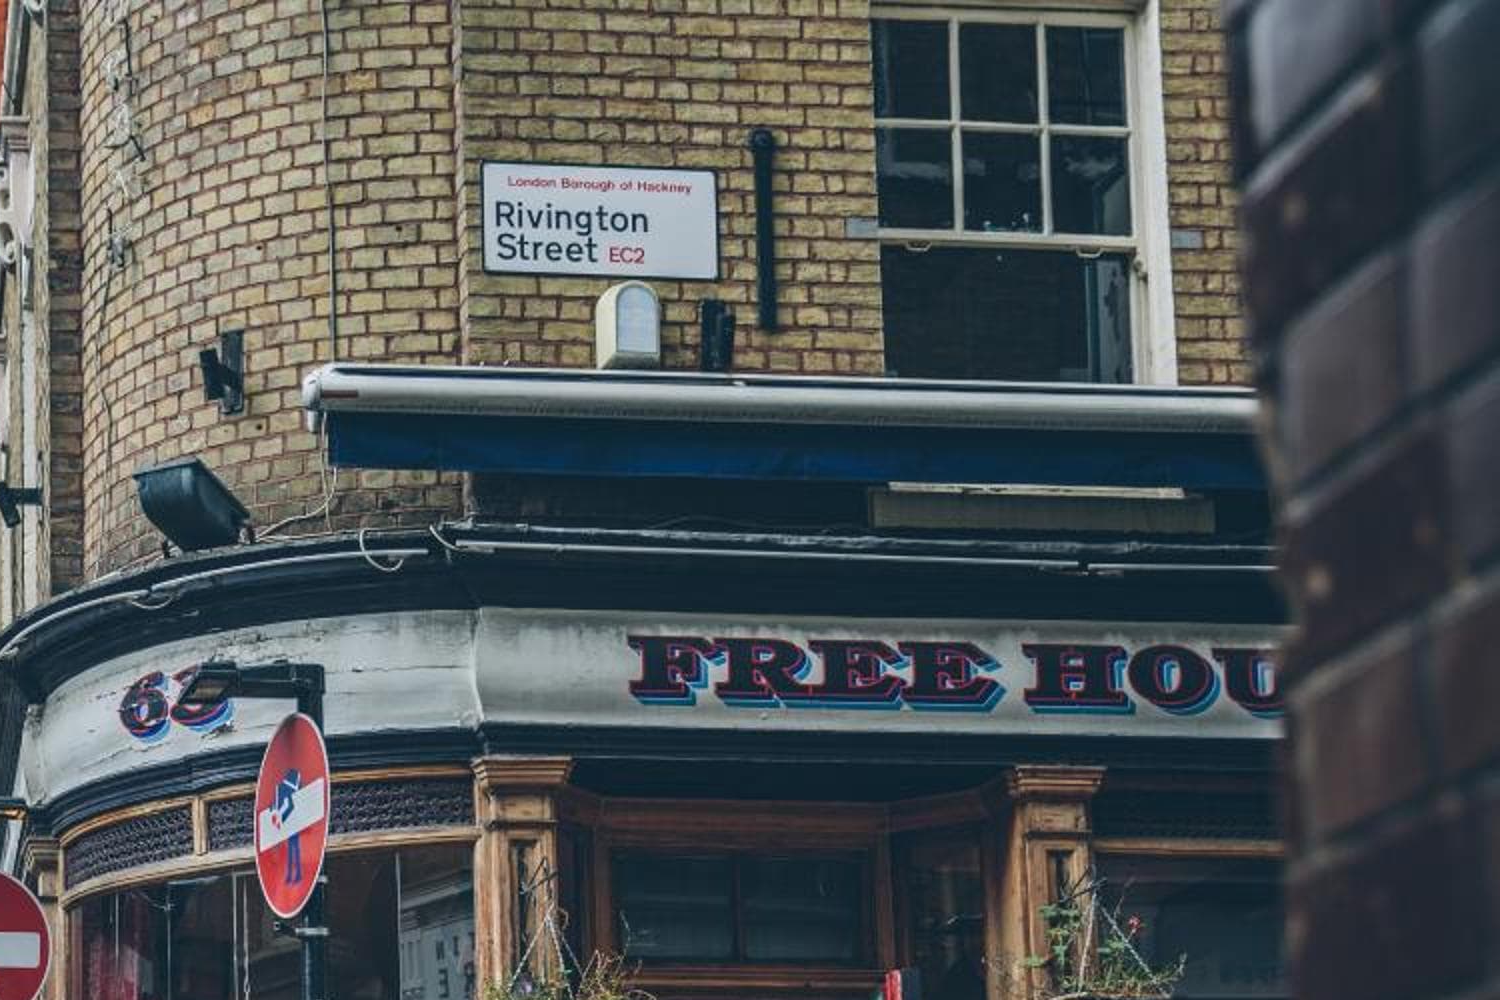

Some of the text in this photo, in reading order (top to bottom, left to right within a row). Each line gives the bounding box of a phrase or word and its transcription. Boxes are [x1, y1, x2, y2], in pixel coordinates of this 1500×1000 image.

[507, 175, 692, 195] London Borough of Hackney
[495, 201, 649, 236] Rivington
[497, 233, 646, 264] Street EC2
[628, 634, 1005, 713] FREE
